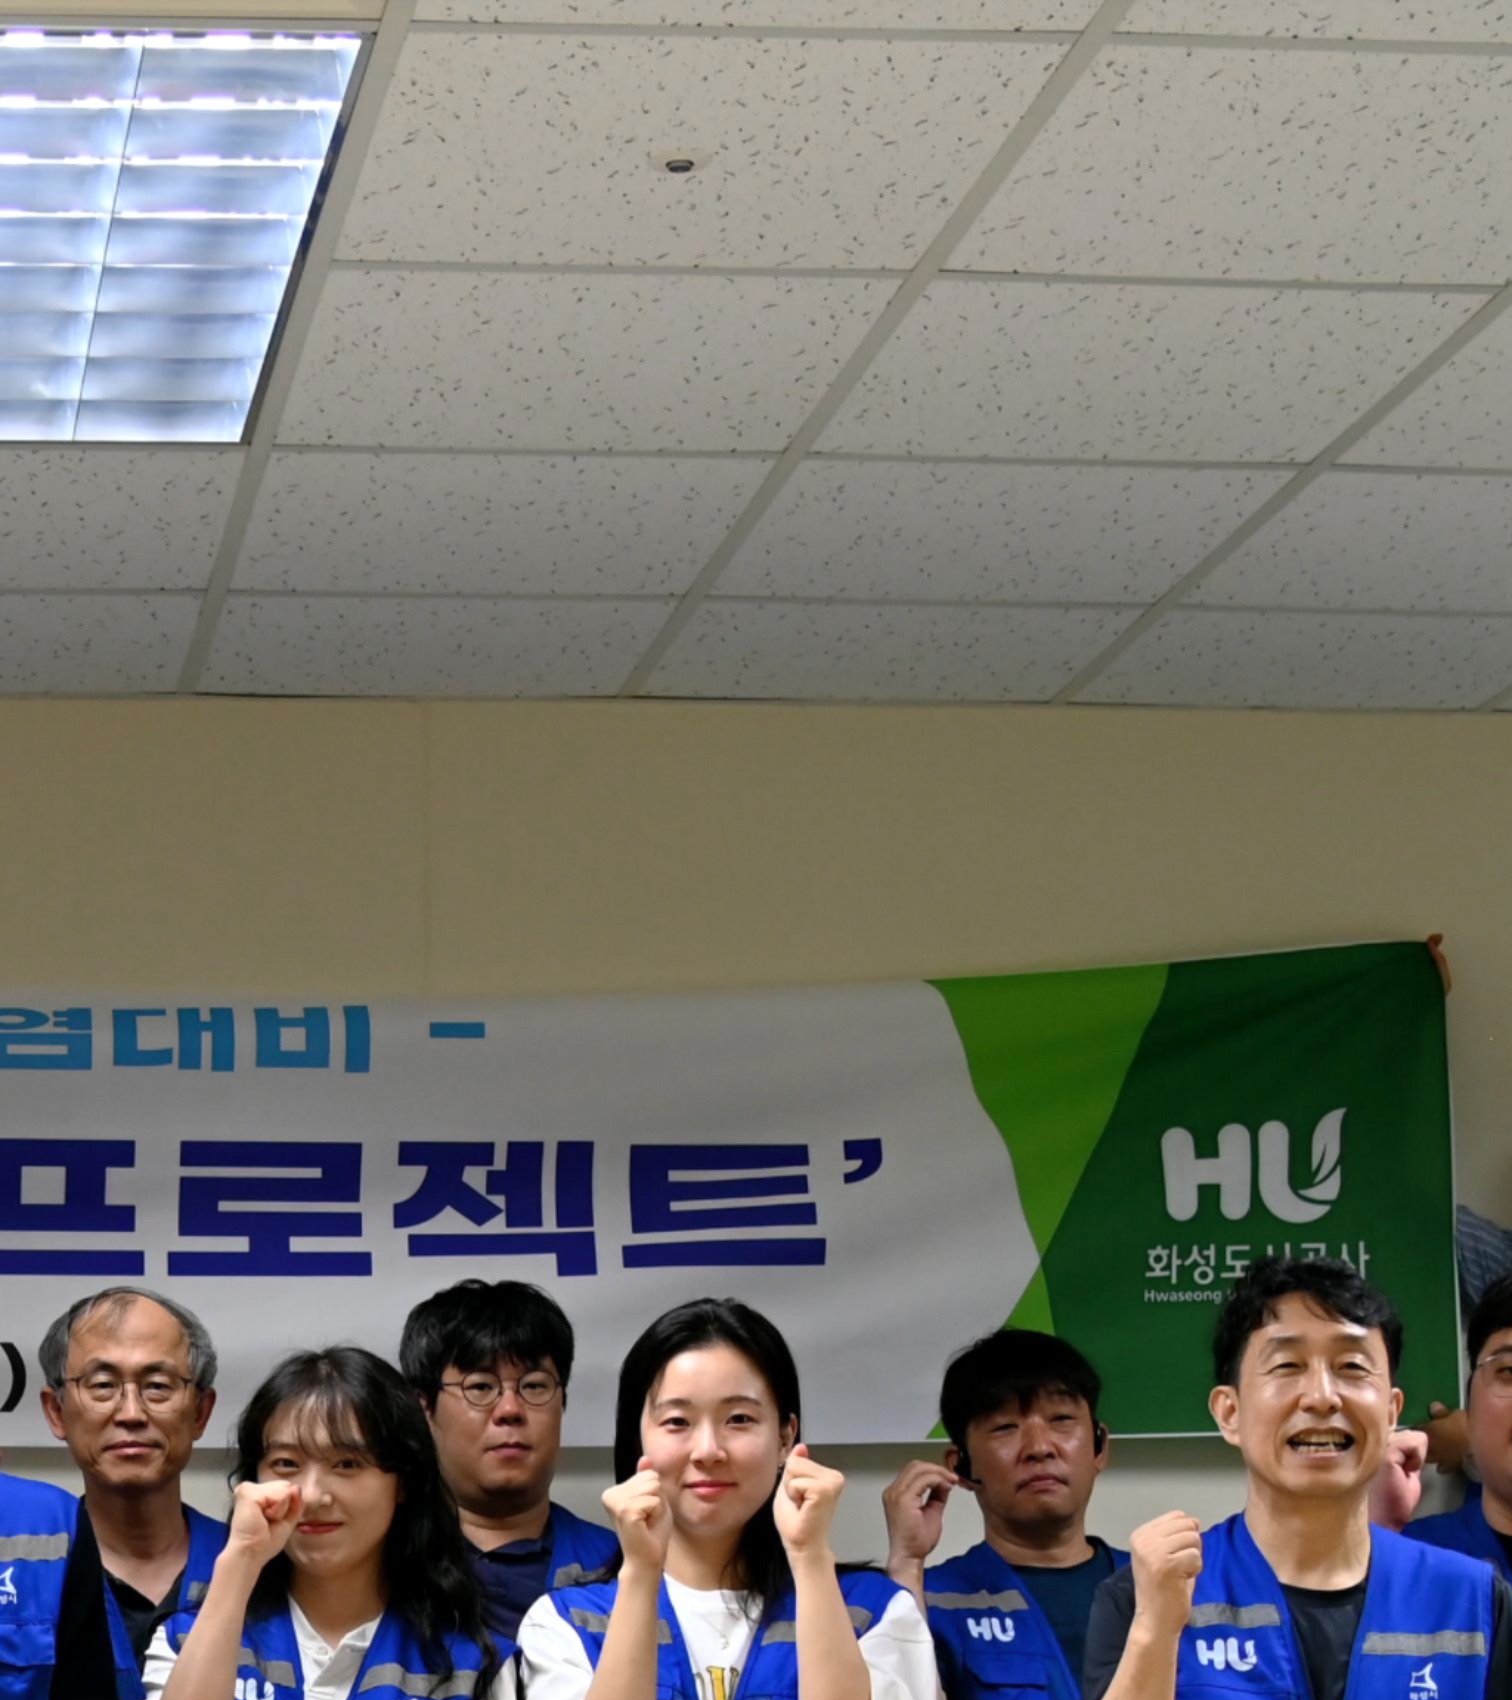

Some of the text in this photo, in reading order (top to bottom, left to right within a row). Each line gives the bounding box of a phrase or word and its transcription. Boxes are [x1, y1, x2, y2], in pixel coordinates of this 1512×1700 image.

[1161, 1107, 1347, 1224] HU
[1144, 1289, 1222, 1304] Hwaseong
[966, 1616, 1015, 1642] HU
[1195, 1637, 1257, 1672] HU
